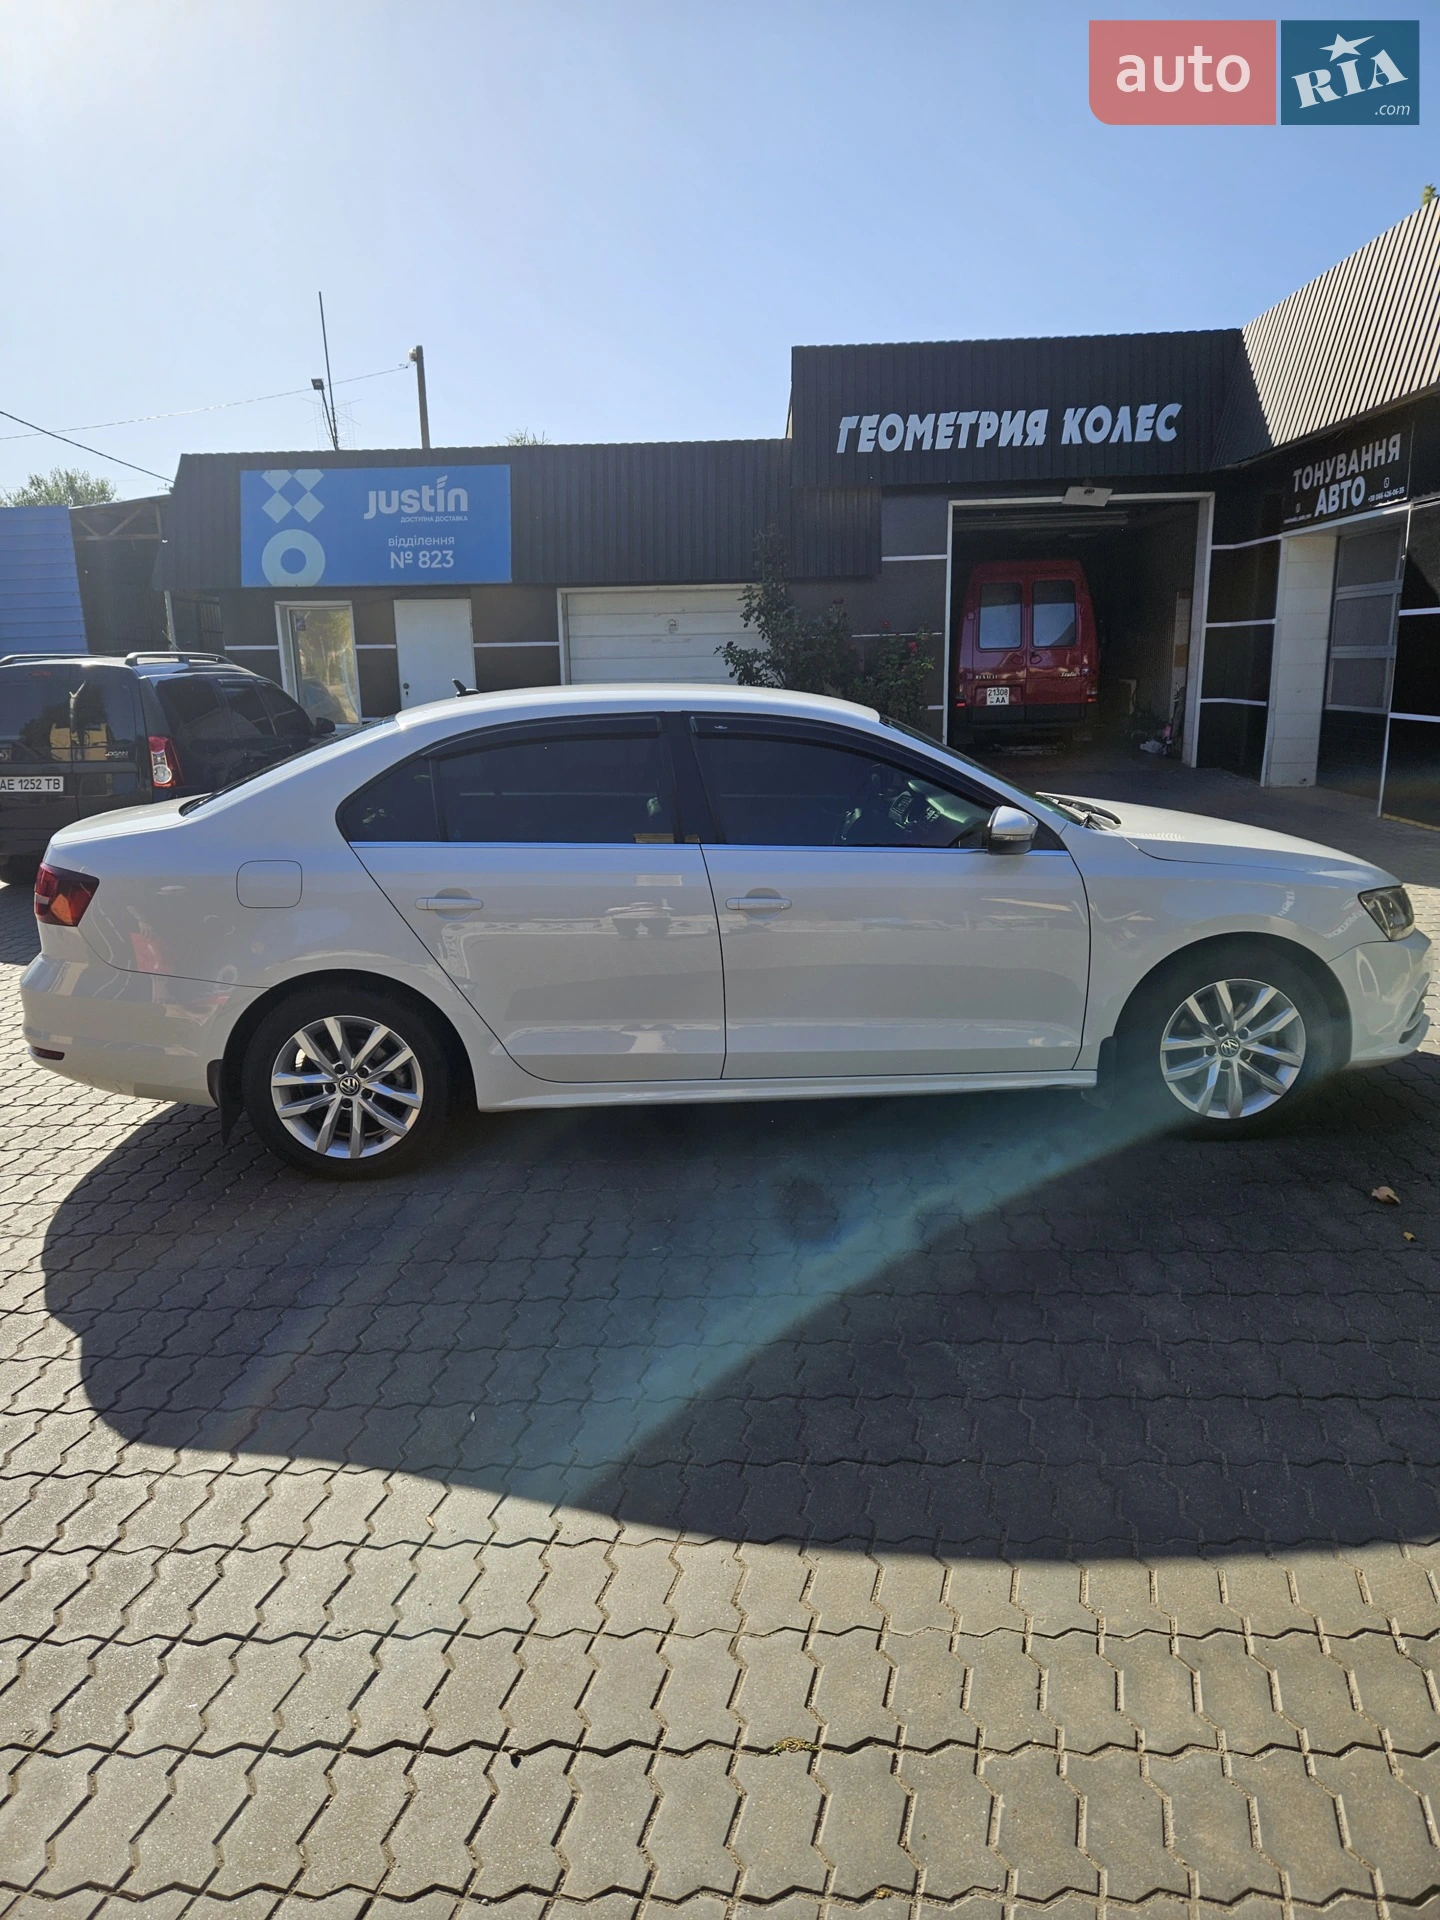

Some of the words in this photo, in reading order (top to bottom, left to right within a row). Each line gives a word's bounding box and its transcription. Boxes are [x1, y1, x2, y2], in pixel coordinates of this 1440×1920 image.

[836, 409, 1049, 453] ГЕОМЕТРИЯ
[1061, 403, 1182, 445] КОЛЕС
[1293, 433, 1401, 493] ТОНУВАННЯ
[1314, 475, 1366, 517] АВТО
[388, 535, 455, 547] відділення
[418, 550, 454, 568] 823
[987, 688, 1009, 697] 21308
[995, 696, 1006, 704] AA
[0, 779, 15, 790] AE
[18, 779, 42, 790] 1252
[44, 778, 61, 789] TB
